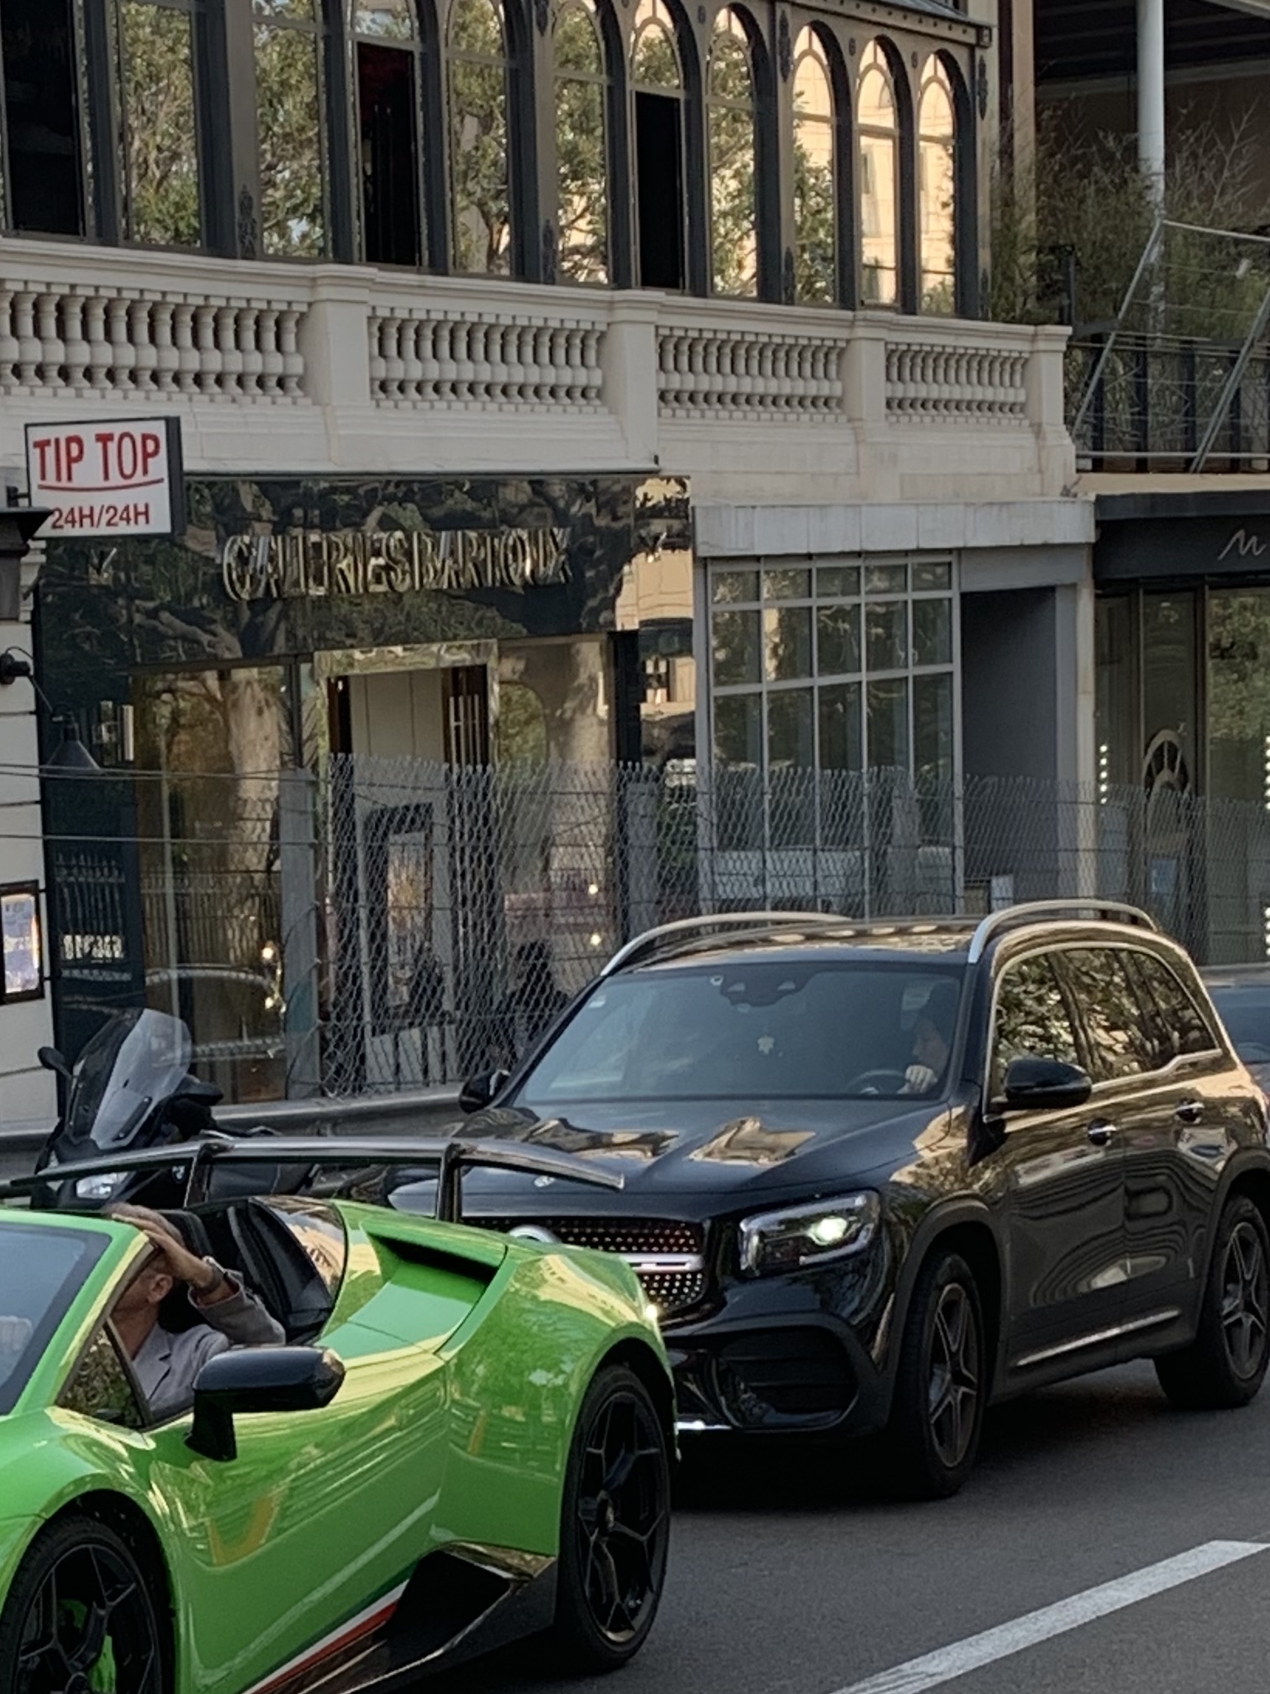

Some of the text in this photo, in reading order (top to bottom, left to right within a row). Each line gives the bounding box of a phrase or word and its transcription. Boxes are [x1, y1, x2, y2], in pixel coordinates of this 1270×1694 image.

[33, 432, 160, 482] TIP TOP
[51, 502, 149, 530] 24H/24H
